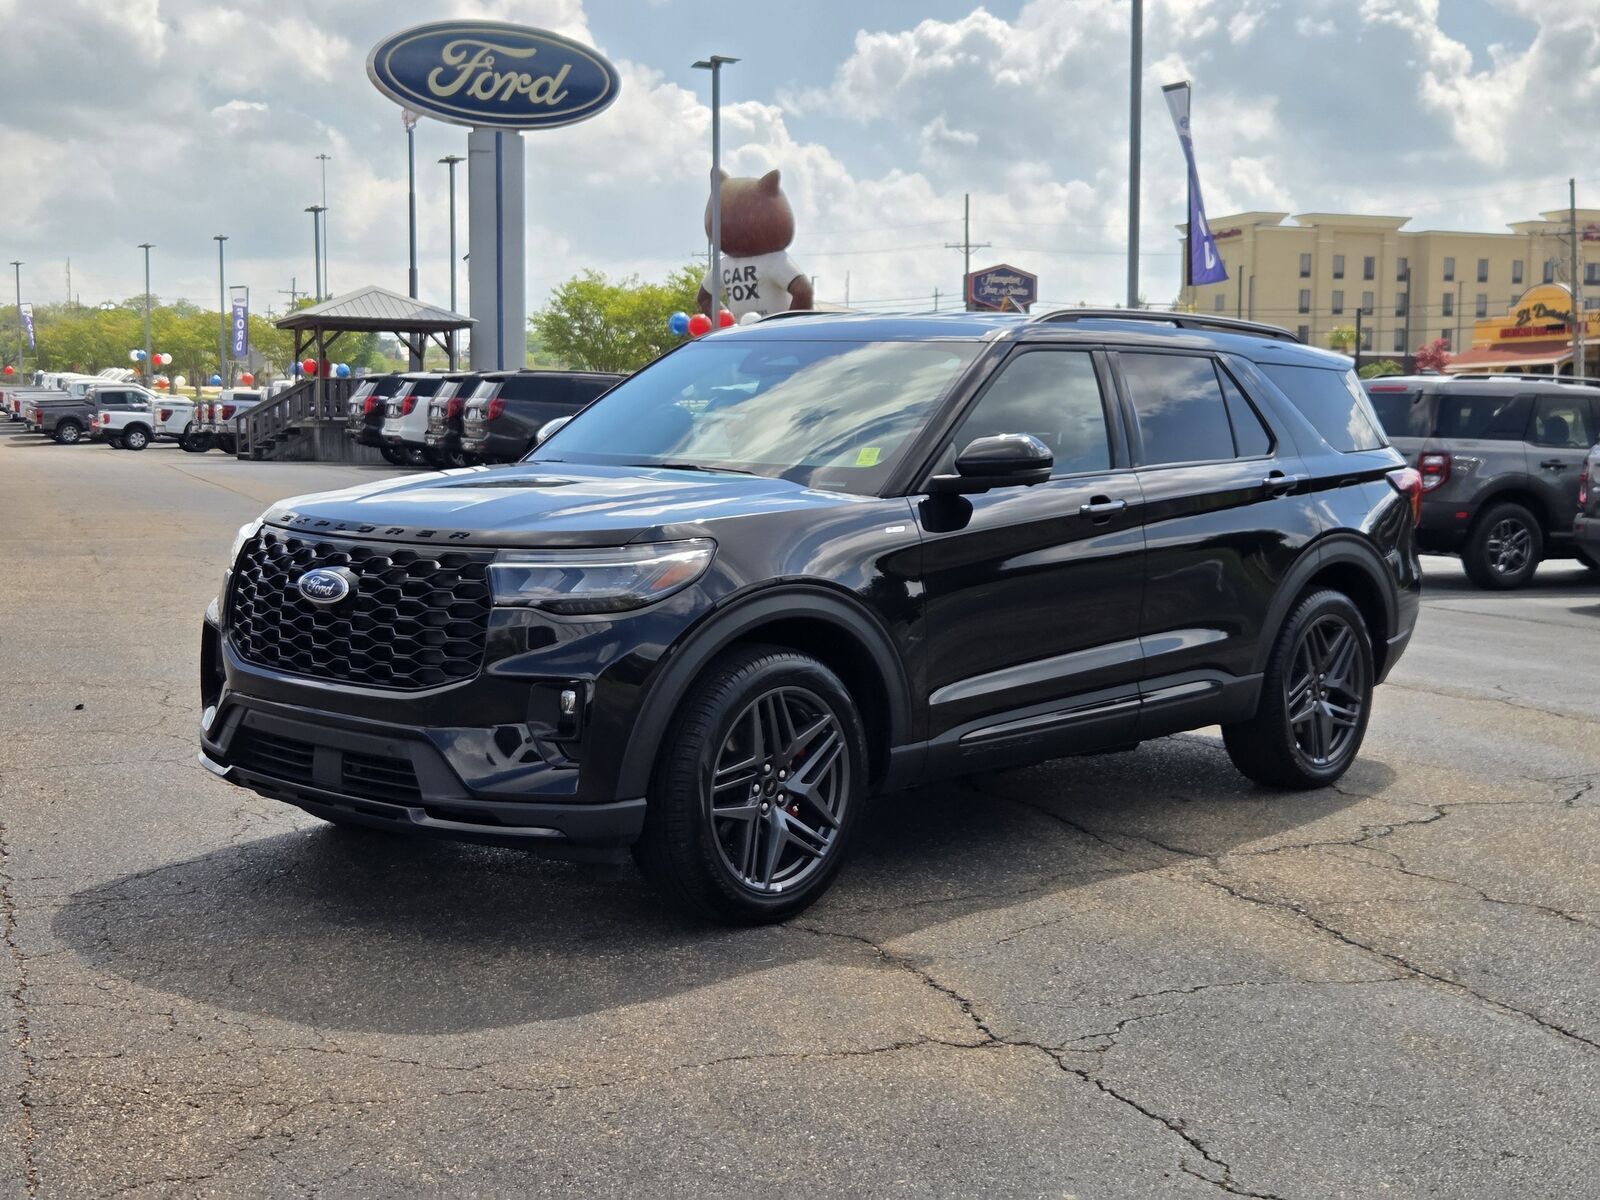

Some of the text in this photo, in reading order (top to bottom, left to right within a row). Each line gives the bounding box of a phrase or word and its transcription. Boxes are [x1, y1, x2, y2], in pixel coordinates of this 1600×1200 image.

[427, 39, 572, 105] Ford
[723, 265, 758, 285] CAR
[726, 283, 760, 301] FOX
[280, 514, 472, 540] EXPLORER
[306, 576, 335, 597] Ford
